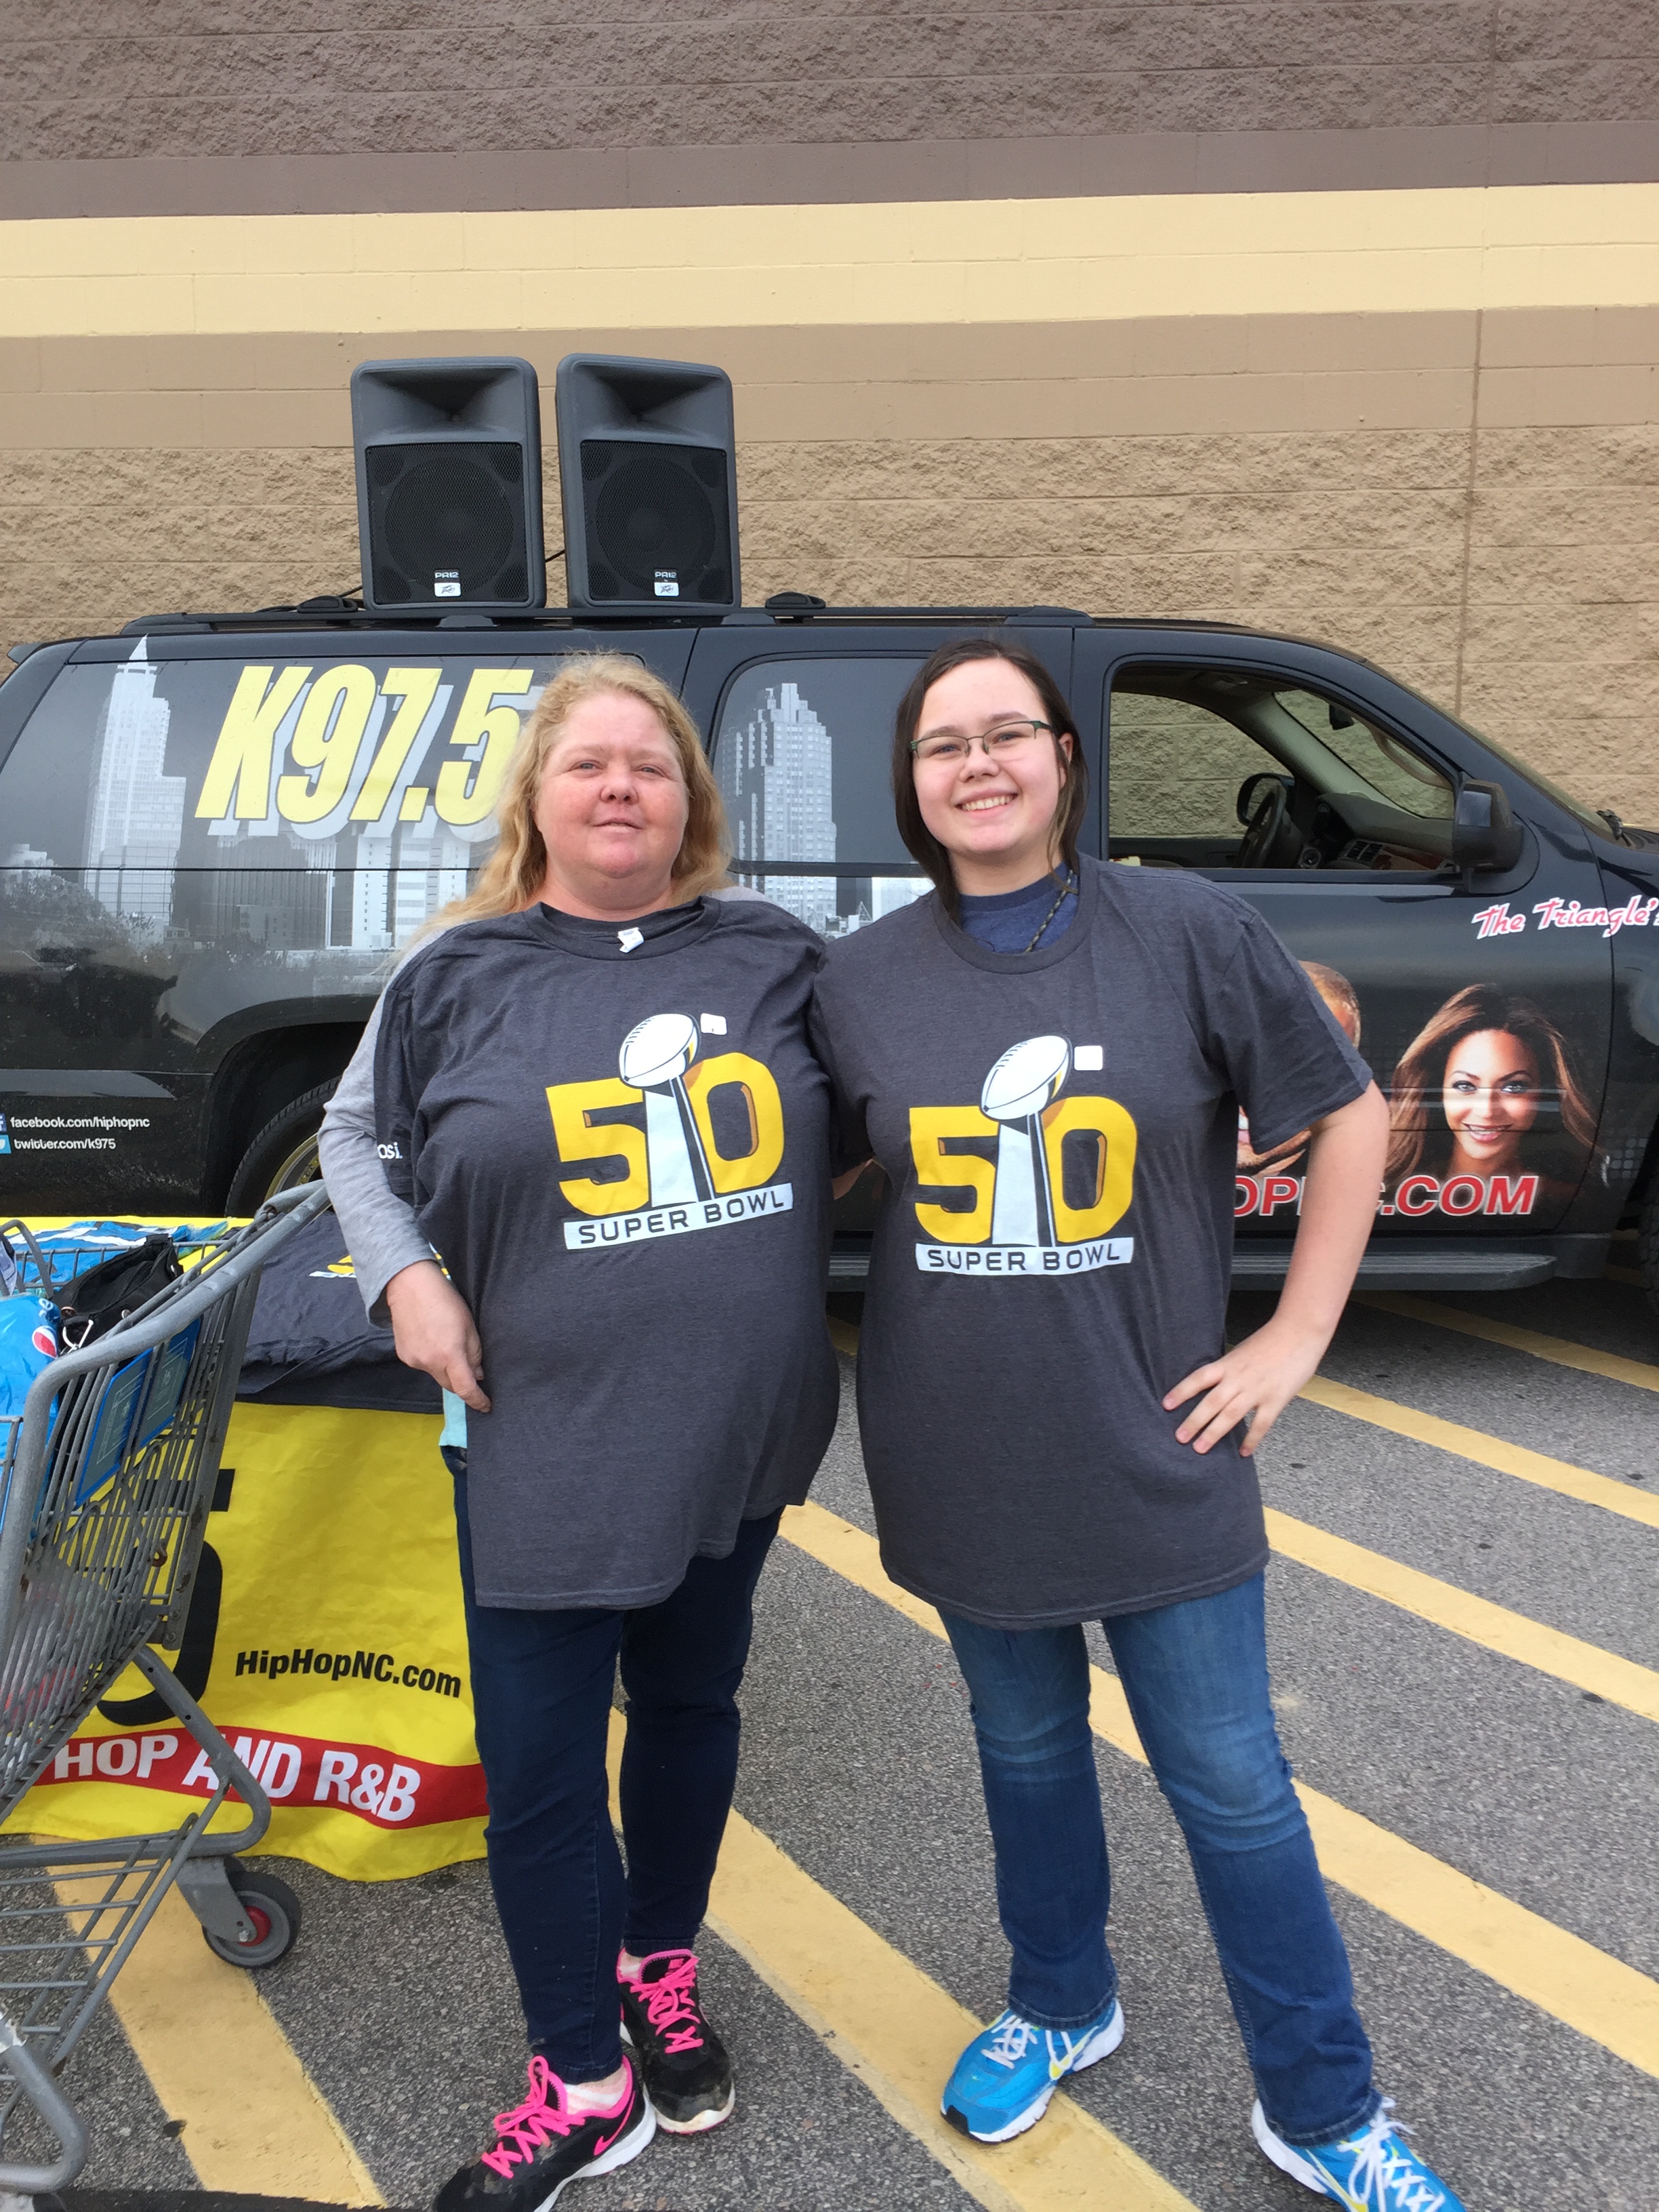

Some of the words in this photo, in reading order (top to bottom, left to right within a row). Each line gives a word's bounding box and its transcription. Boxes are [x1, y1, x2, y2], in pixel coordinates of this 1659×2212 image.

[194, 663, 535, 825] K97.5
[1471, 903, 1526, 939] The
[1532, 895, 1659, 938] Triangle'
[10, 1116, 150, 1131] facebook.com/hiphopnc
[14, 1138, 117, 1150] twitter.com/k975
[579, 1210, 689, 1244] SUPER
[704, 1191, 784, 1224] BOWL
[927, 1248, 1026, 1271] SUPER
[1043, 1243, 1120, 1271] BOWL
[235, 1648, 462, 1698] HipHopNC.com
[54, 1734, 178, 1779] HOP
[181, 1734, 302, 1799] AND
[313, 1750, 421, 1822] R&B
